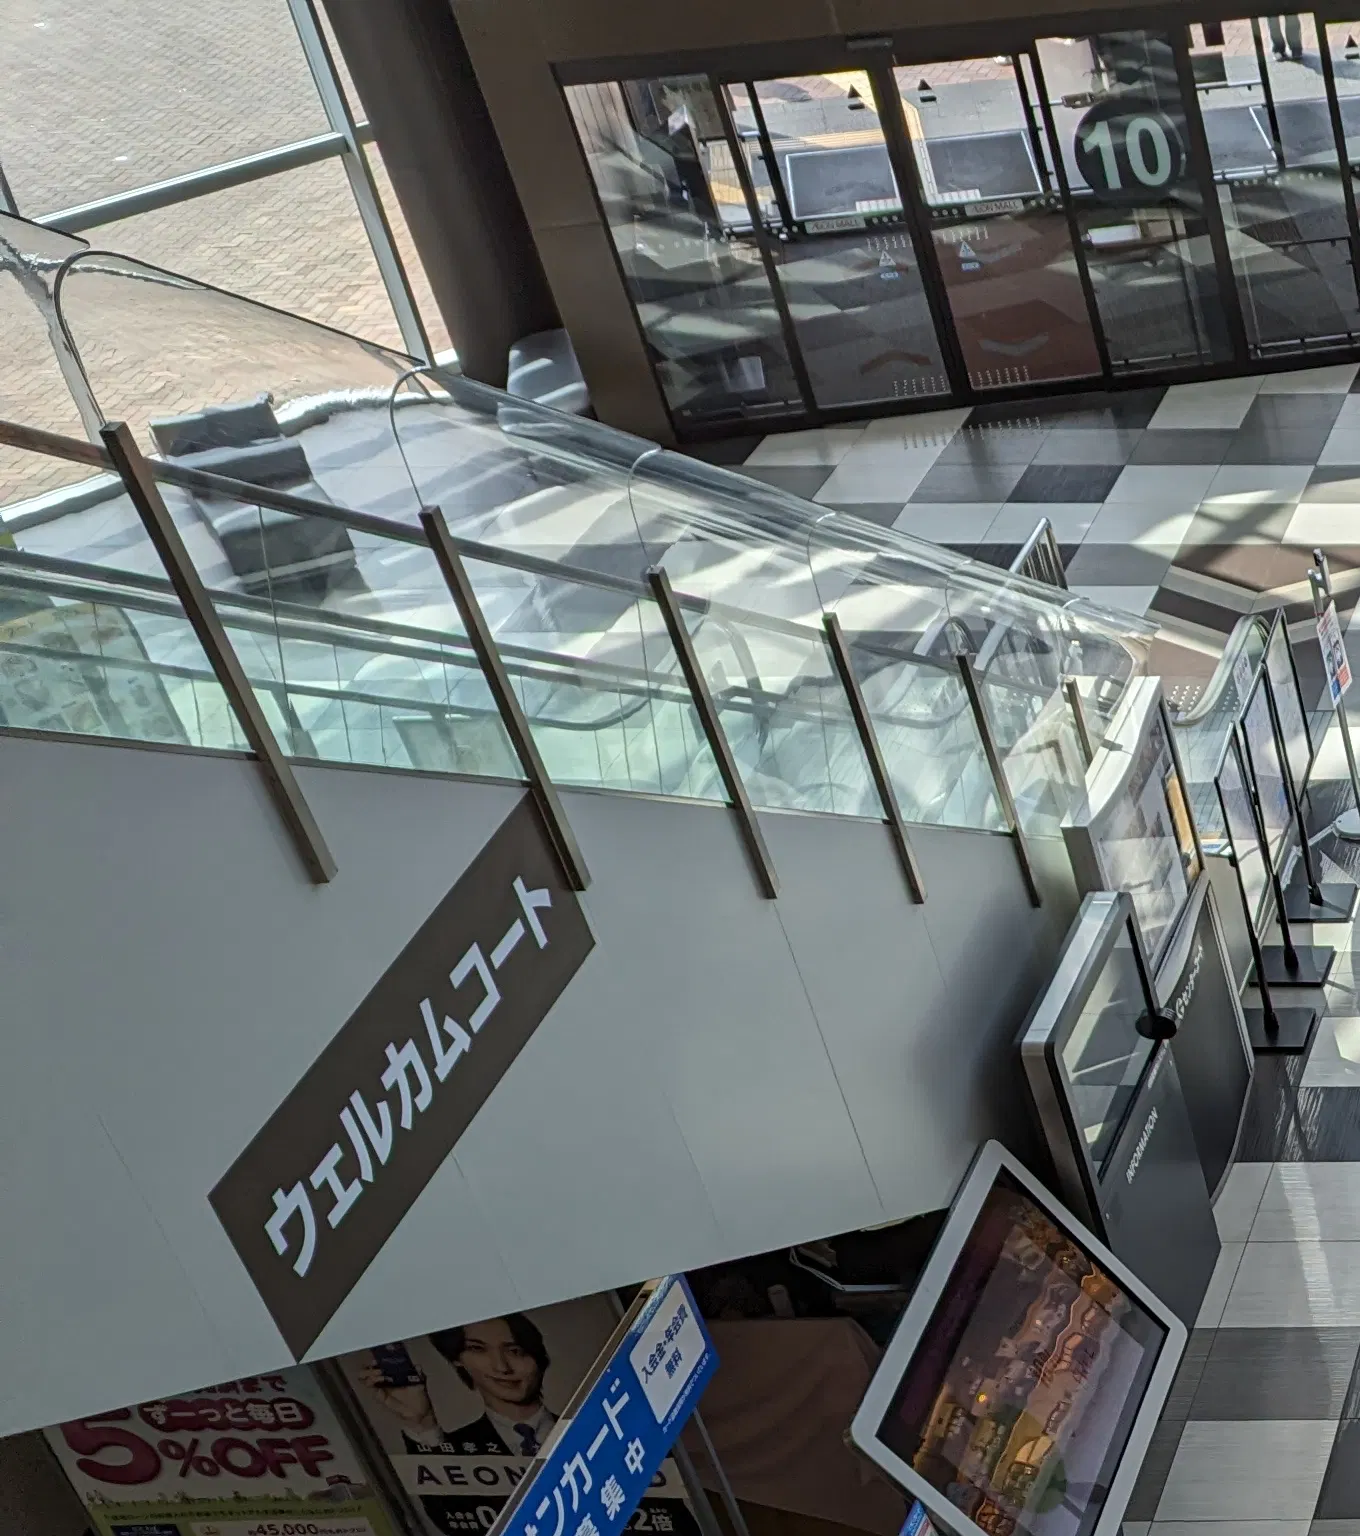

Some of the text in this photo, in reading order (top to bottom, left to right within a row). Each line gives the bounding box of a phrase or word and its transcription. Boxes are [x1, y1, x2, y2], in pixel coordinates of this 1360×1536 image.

[1083, 116, 1171, 189] 10
[264, 875, 552, 1279] ウェルカムコート
[1126, 1105, 1160, 1185] INFORMATION
[639, 1303, 689, 1384] 入会金・年会費
[663, 1346, 683, 1379] 無料
[143, 1402, 302, 1424] ずーっと毎日
[416, 1442, 502, 1454] 山田孝之
